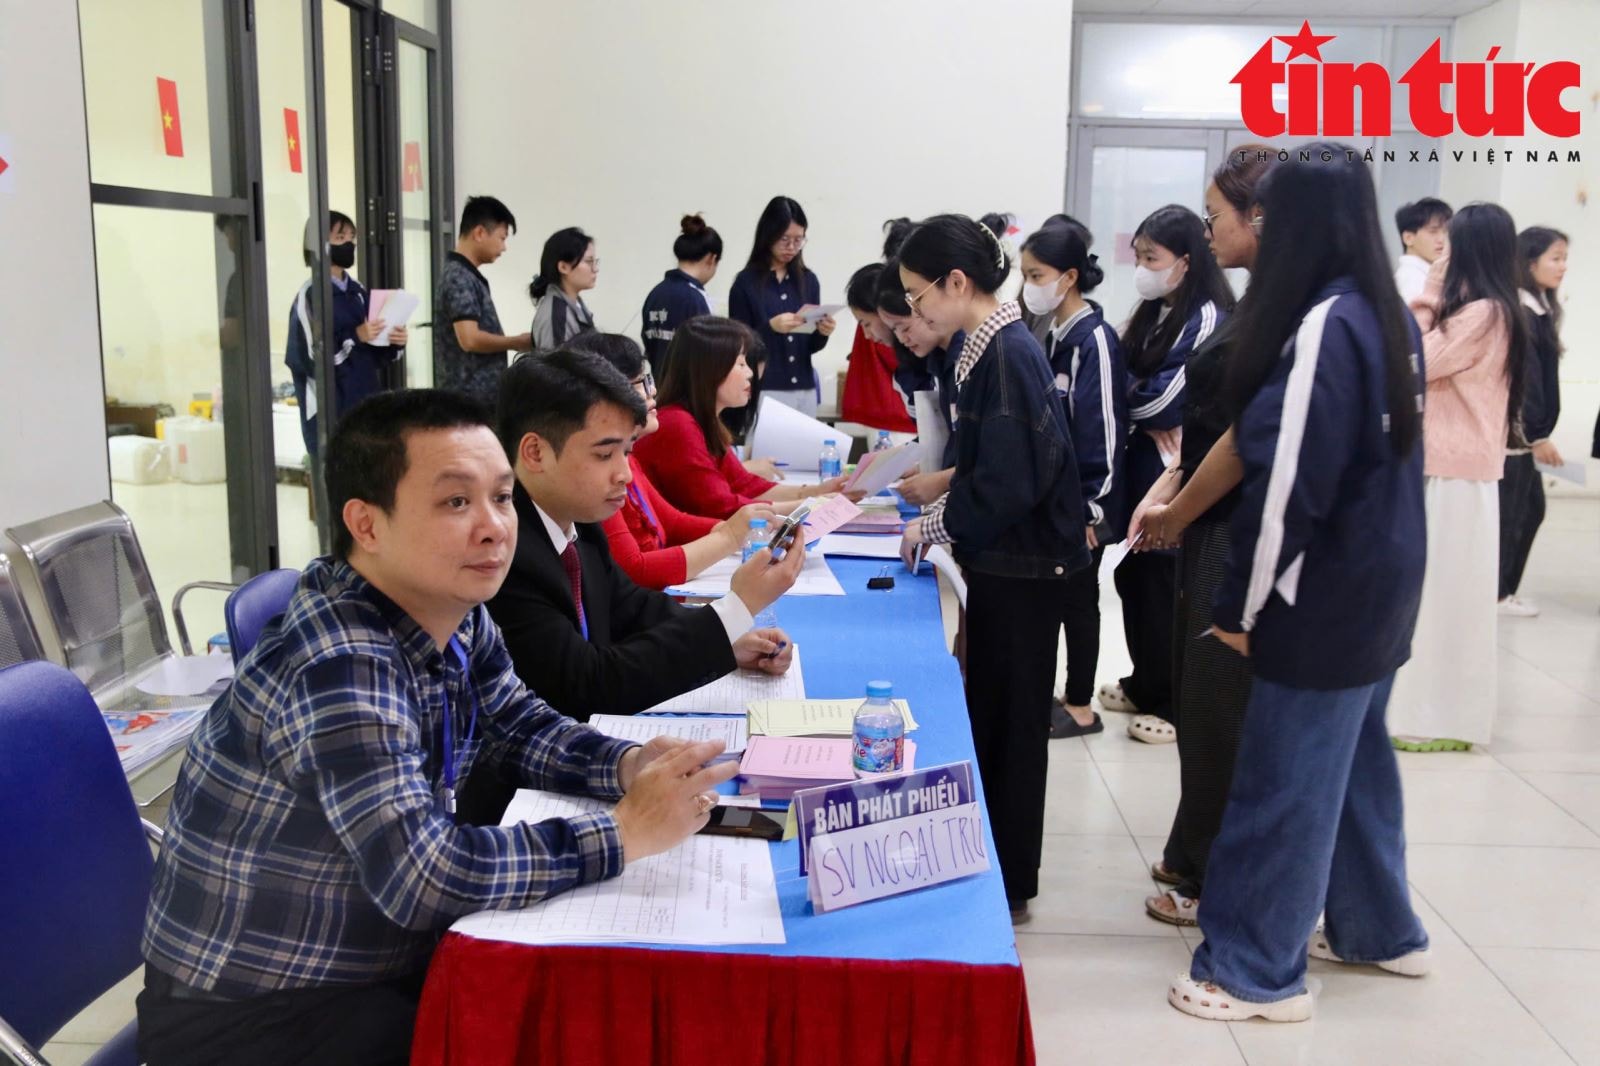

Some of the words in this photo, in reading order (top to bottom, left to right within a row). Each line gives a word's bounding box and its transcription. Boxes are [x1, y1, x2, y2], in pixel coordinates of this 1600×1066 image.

[814, 799, 852, 834] BÀN
[858, 788, 904, 825] PHÁT
[908, 775, 959, 815] PHIẾU
[822, 843, 856, 897] SV
